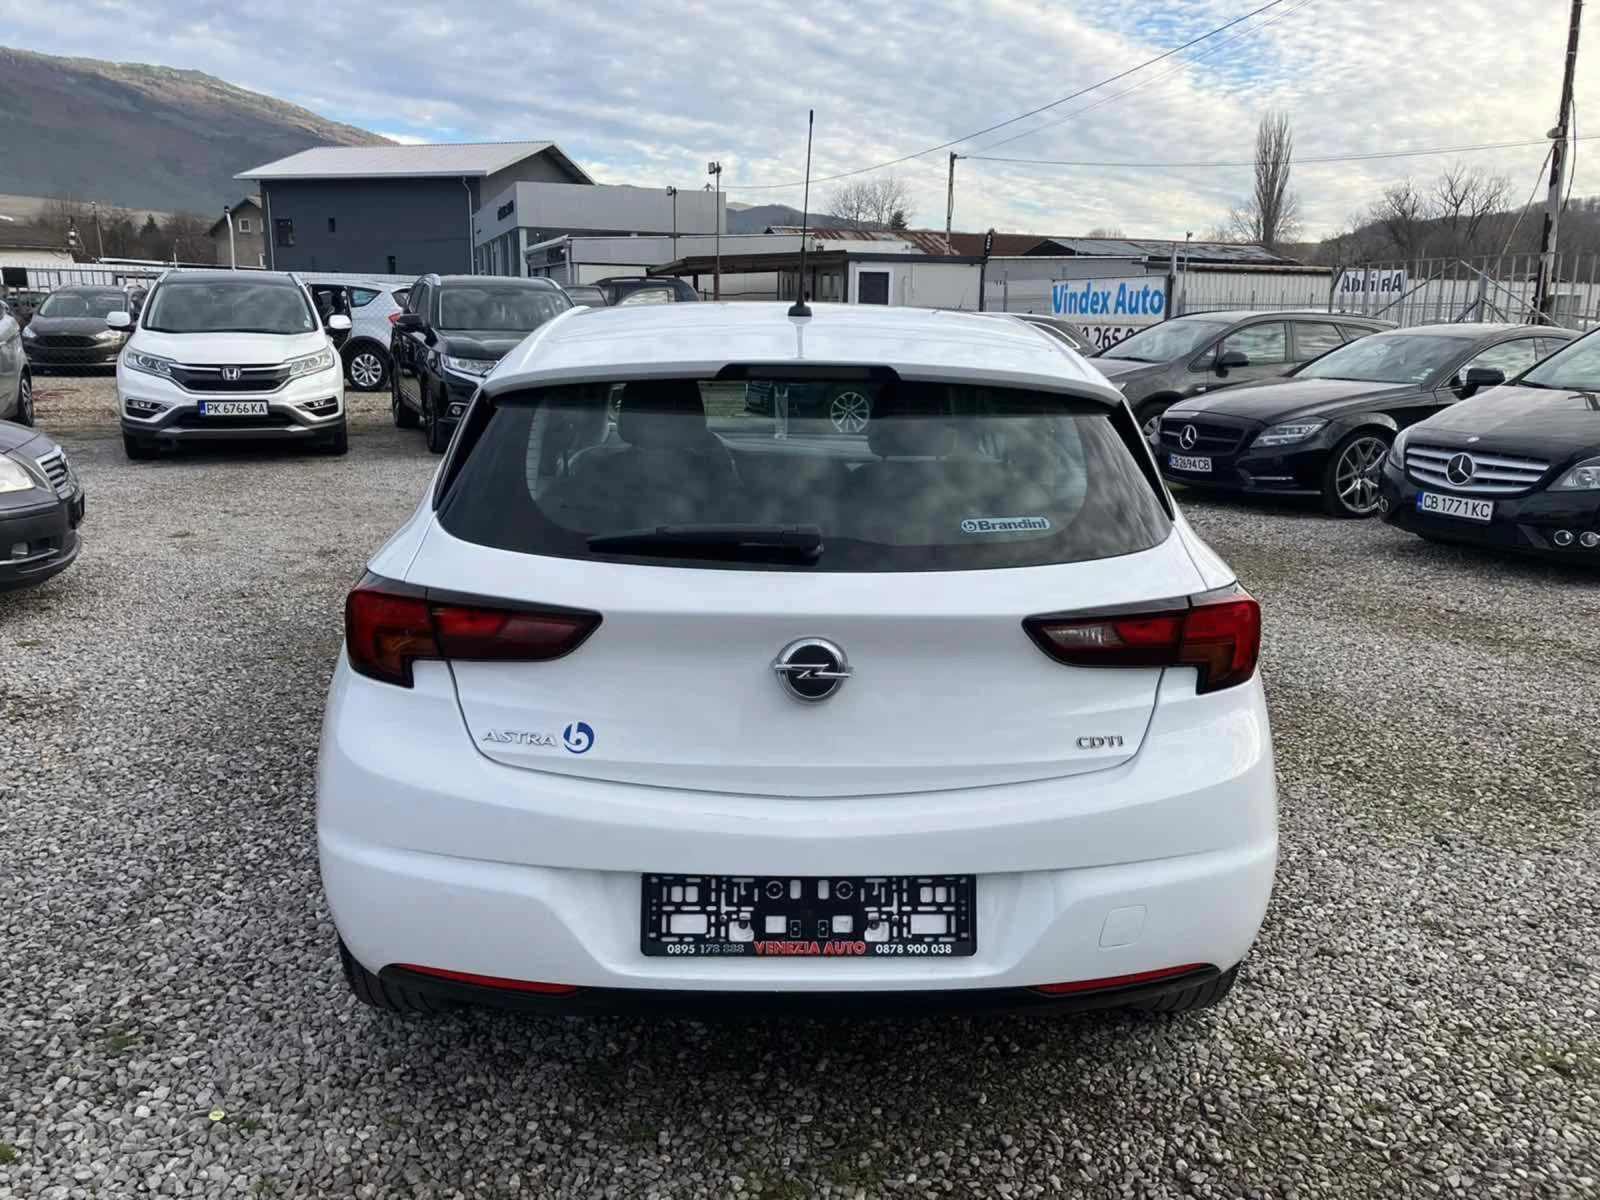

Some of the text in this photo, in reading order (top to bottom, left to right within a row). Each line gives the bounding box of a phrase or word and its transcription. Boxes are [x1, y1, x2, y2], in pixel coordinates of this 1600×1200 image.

[1052, 282, 1165, 315] Vindex Auto
[207, 403, 265, 414] PK 6766 KA
[1424, 494, 1490, 518] CB 1771 KC
[977, 518, 1047, 531] Brandini
[482, 728, 557, 747] ASTRA
[667, 944, 696, 954] 0895
[753, 940, 820, 954] VENEZIA
[823, 940, 866, 954] AUTO
[875, 944, 904, 954] 0878
[906, 944, 929, 954] 900
[930, 944, 952, 954] 038
